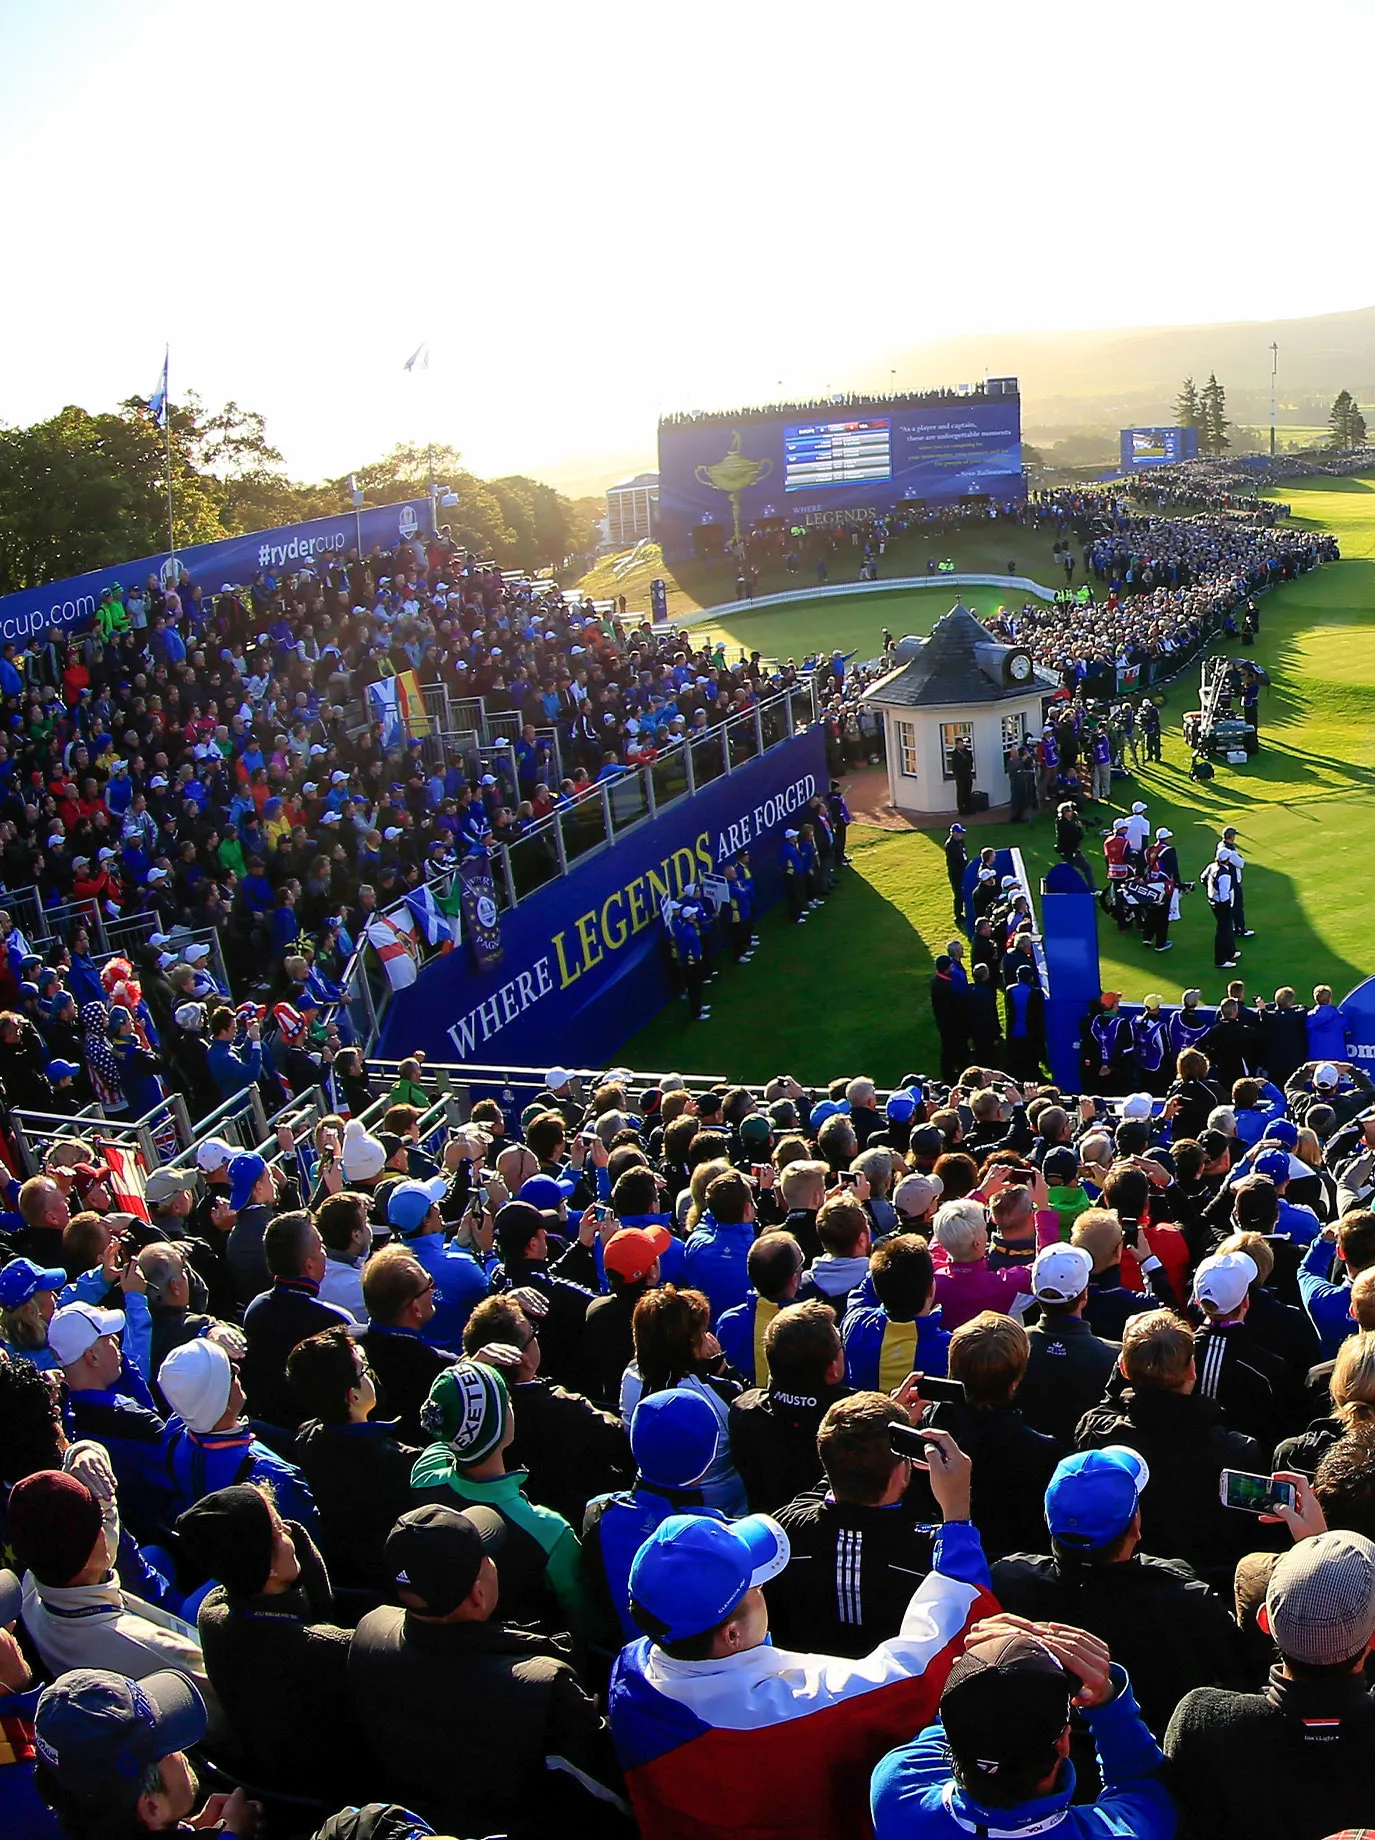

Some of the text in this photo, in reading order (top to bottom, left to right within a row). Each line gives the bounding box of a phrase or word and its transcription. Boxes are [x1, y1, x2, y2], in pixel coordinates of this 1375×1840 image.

[916, 424, 937, 433] player
[938, 422, 950, 430] and
[937, 431, 980, 441] unforgettable
[792, 504, 822, 513] WHERE
[805, 507, 876, 526] LEGENDS
[258, 532, 345, 567] #rydercup
[1128, 882, 1158, 901] USA
[446, 773, 816, 1060] WHERE LEGENDS ARE FORGED
[773, 1390, 817, 1408] MUSTO
